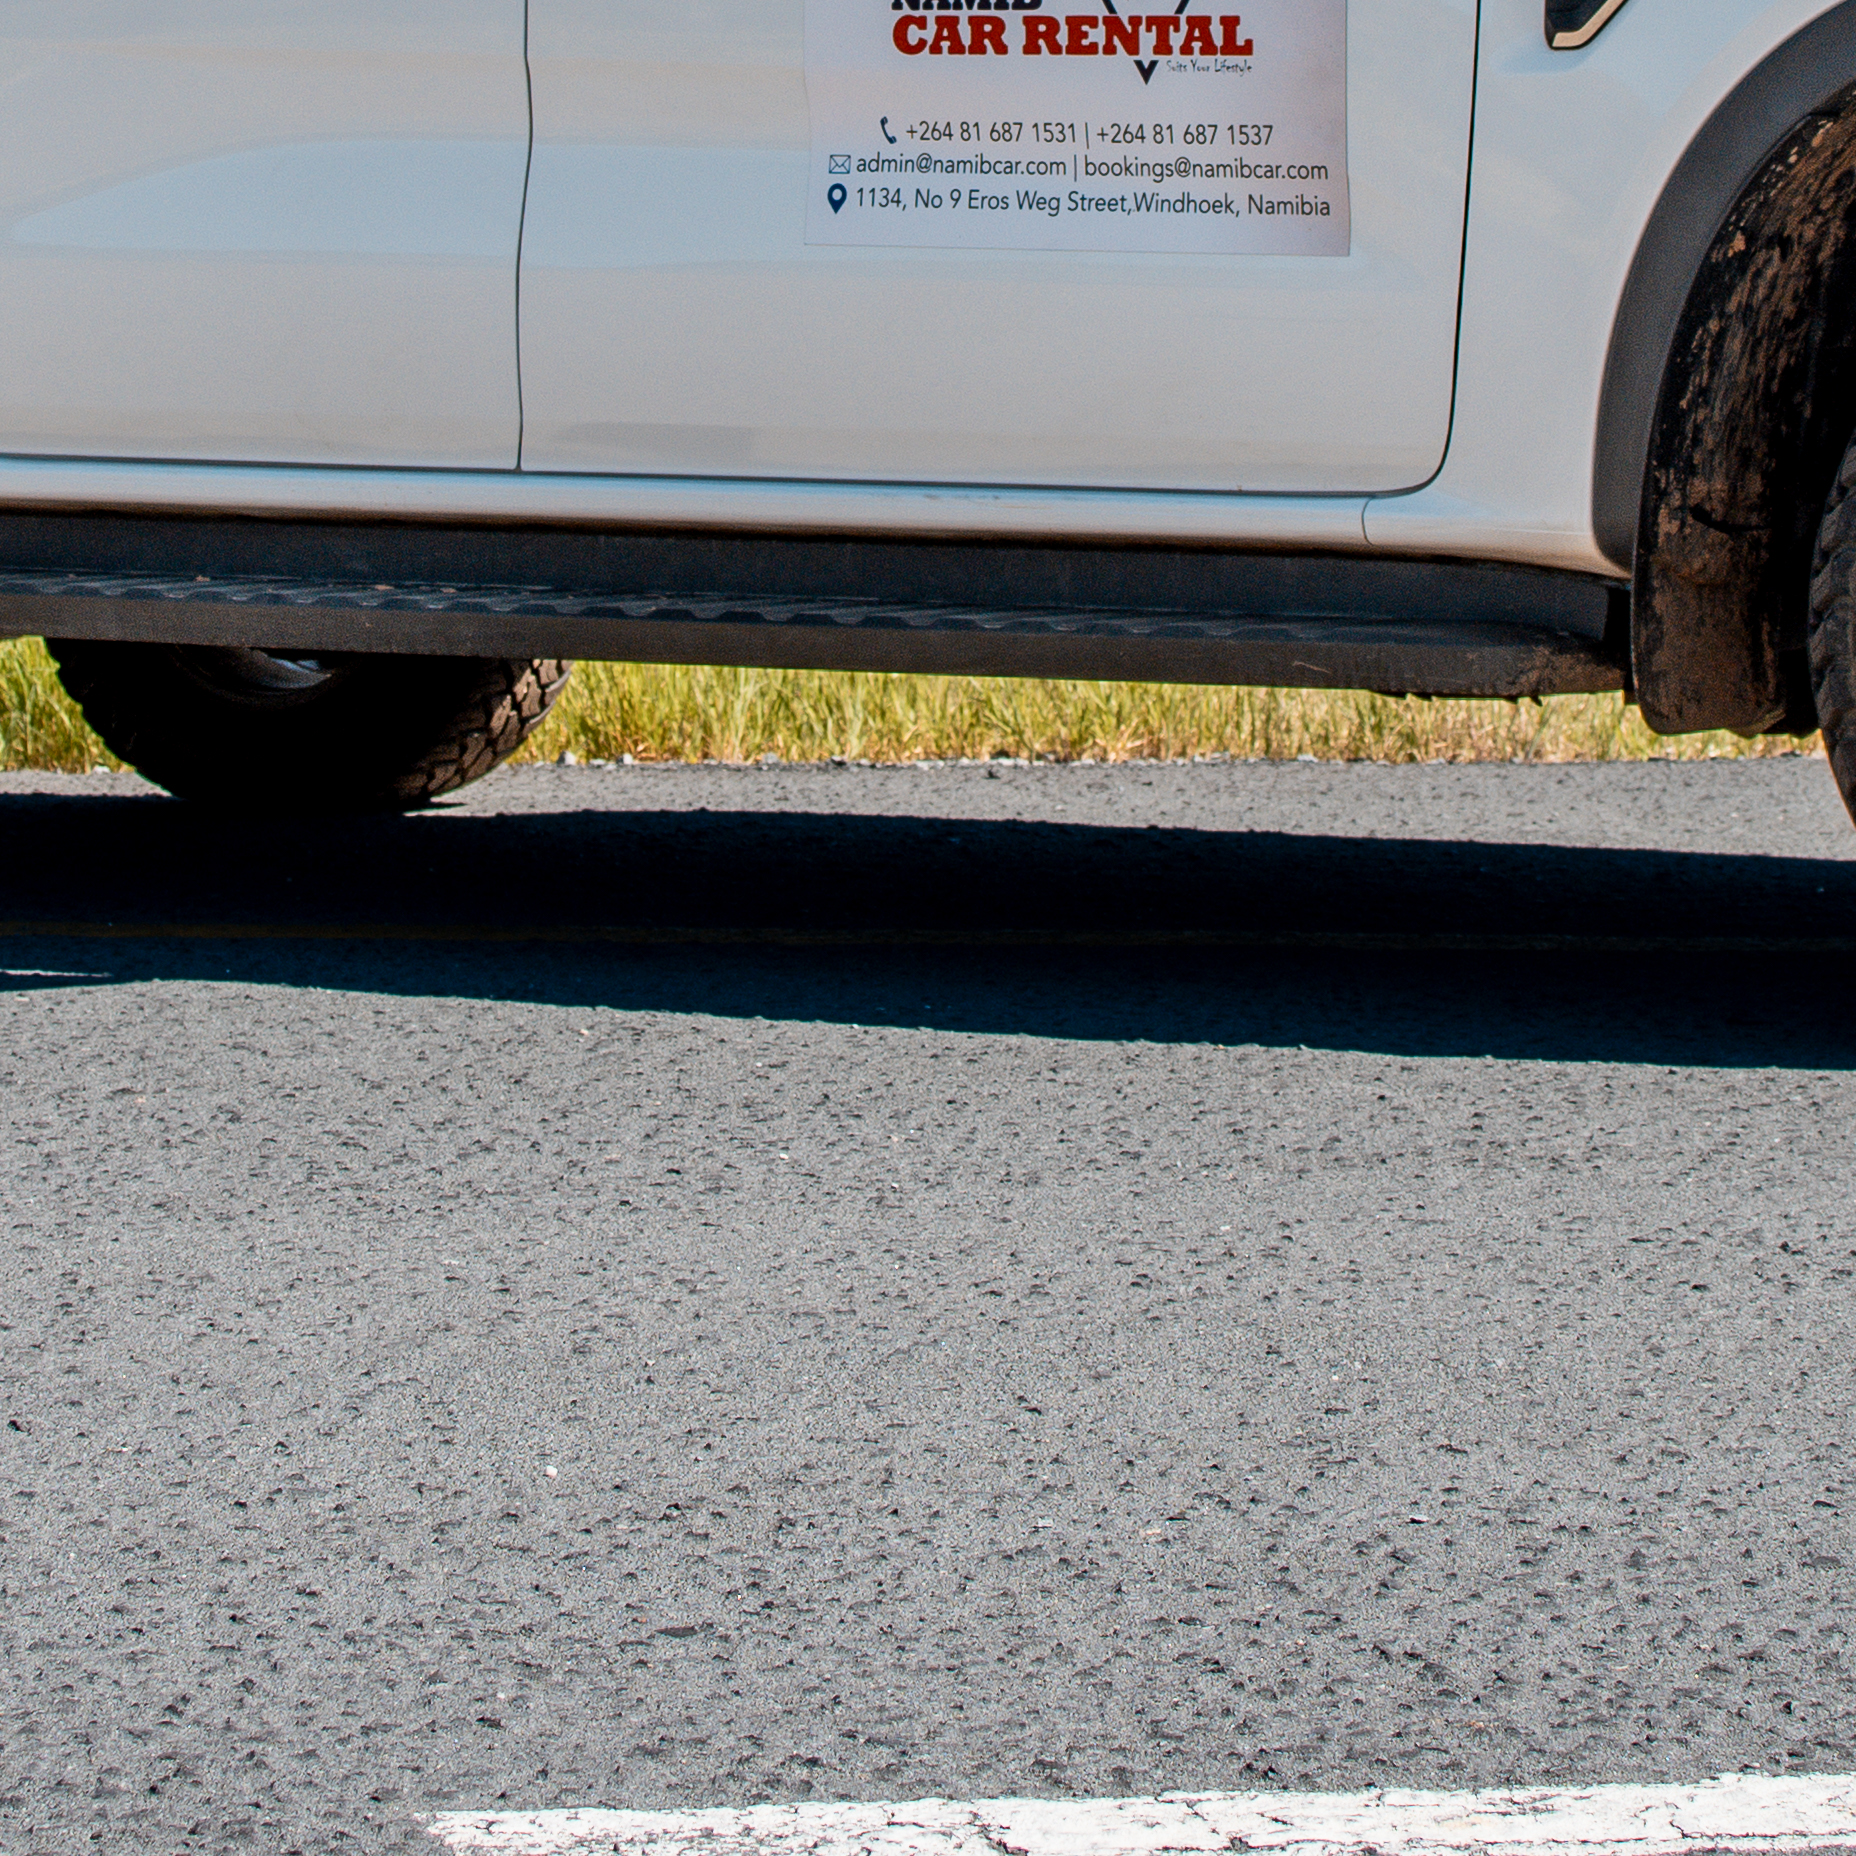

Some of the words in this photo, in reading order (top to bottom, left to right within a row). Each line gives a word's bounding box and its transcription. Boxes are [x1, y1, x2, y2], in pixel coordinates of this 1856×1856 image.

[892, 14, 1009, 56] CAR
[1022, 14, 1254, 56] RENTAL
[1166, 59, 1188, 73] Suits
[1190, 58, 1210, 73] Your
[1214, 58, 1253, 77] Lifestyle
[906, 120, 954, 142] +264
[960, 121, 981, 142] 81
[989, 121, 1024, 143] 687
[1031, 122, 1076, 144] 1531
[1096, 123, 1147, 145] +264
[1153, 123, 1174, 145] 81
[1183, 124, 1219, 145] 687
[1227, 124, 1274, 146] 1537
[856, 151, 1067, 176] admin@namibcar.com
[1084, 155, 1329, 184] bookings@namibcar.com
[856, 187, 907, 211] 1134,
[915, 188, 944, 209] No
[950, 188, 963, 210] 9
[968, 189, 1010, 211] Eros
[1016, 190, 1061, 217] Weg
[1247, 194, 1331, 217] Namibia
